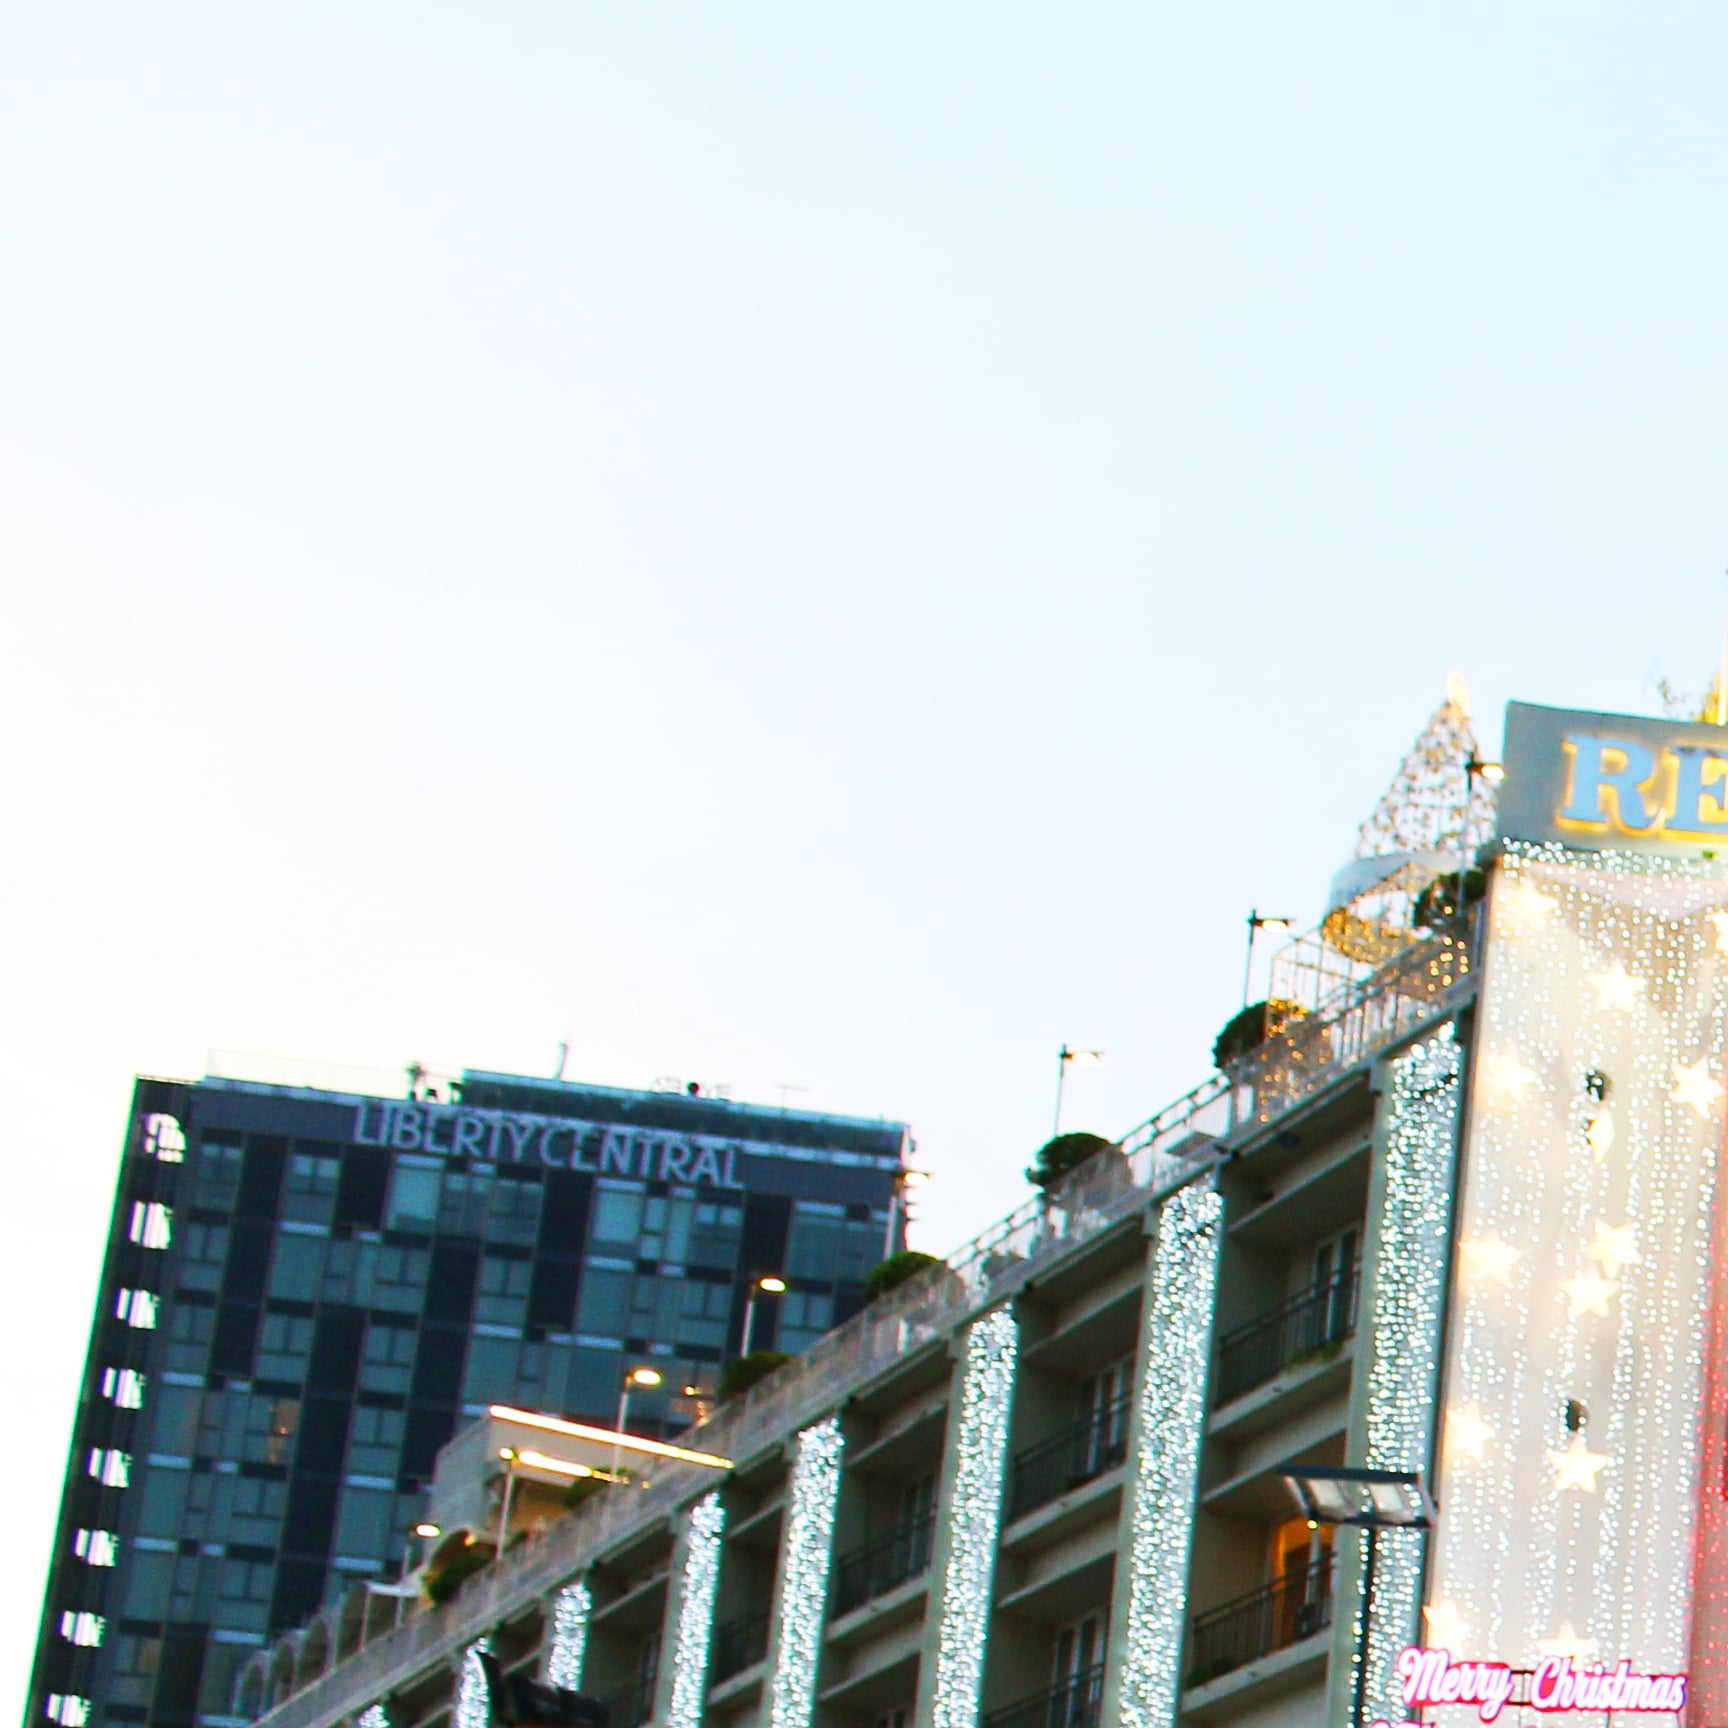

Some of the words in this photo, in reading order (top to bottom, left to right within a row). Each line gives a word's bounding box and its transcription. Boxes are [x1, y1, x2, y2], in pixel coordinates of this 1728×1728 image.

[353, 1103, 531, 1160] LIBERTY
[538, 1127, 745, 1189] CENTRAL
[1399, 1647, 1513, 1722] Merry
[1530, 1655, 1688, 1712] Christmas
